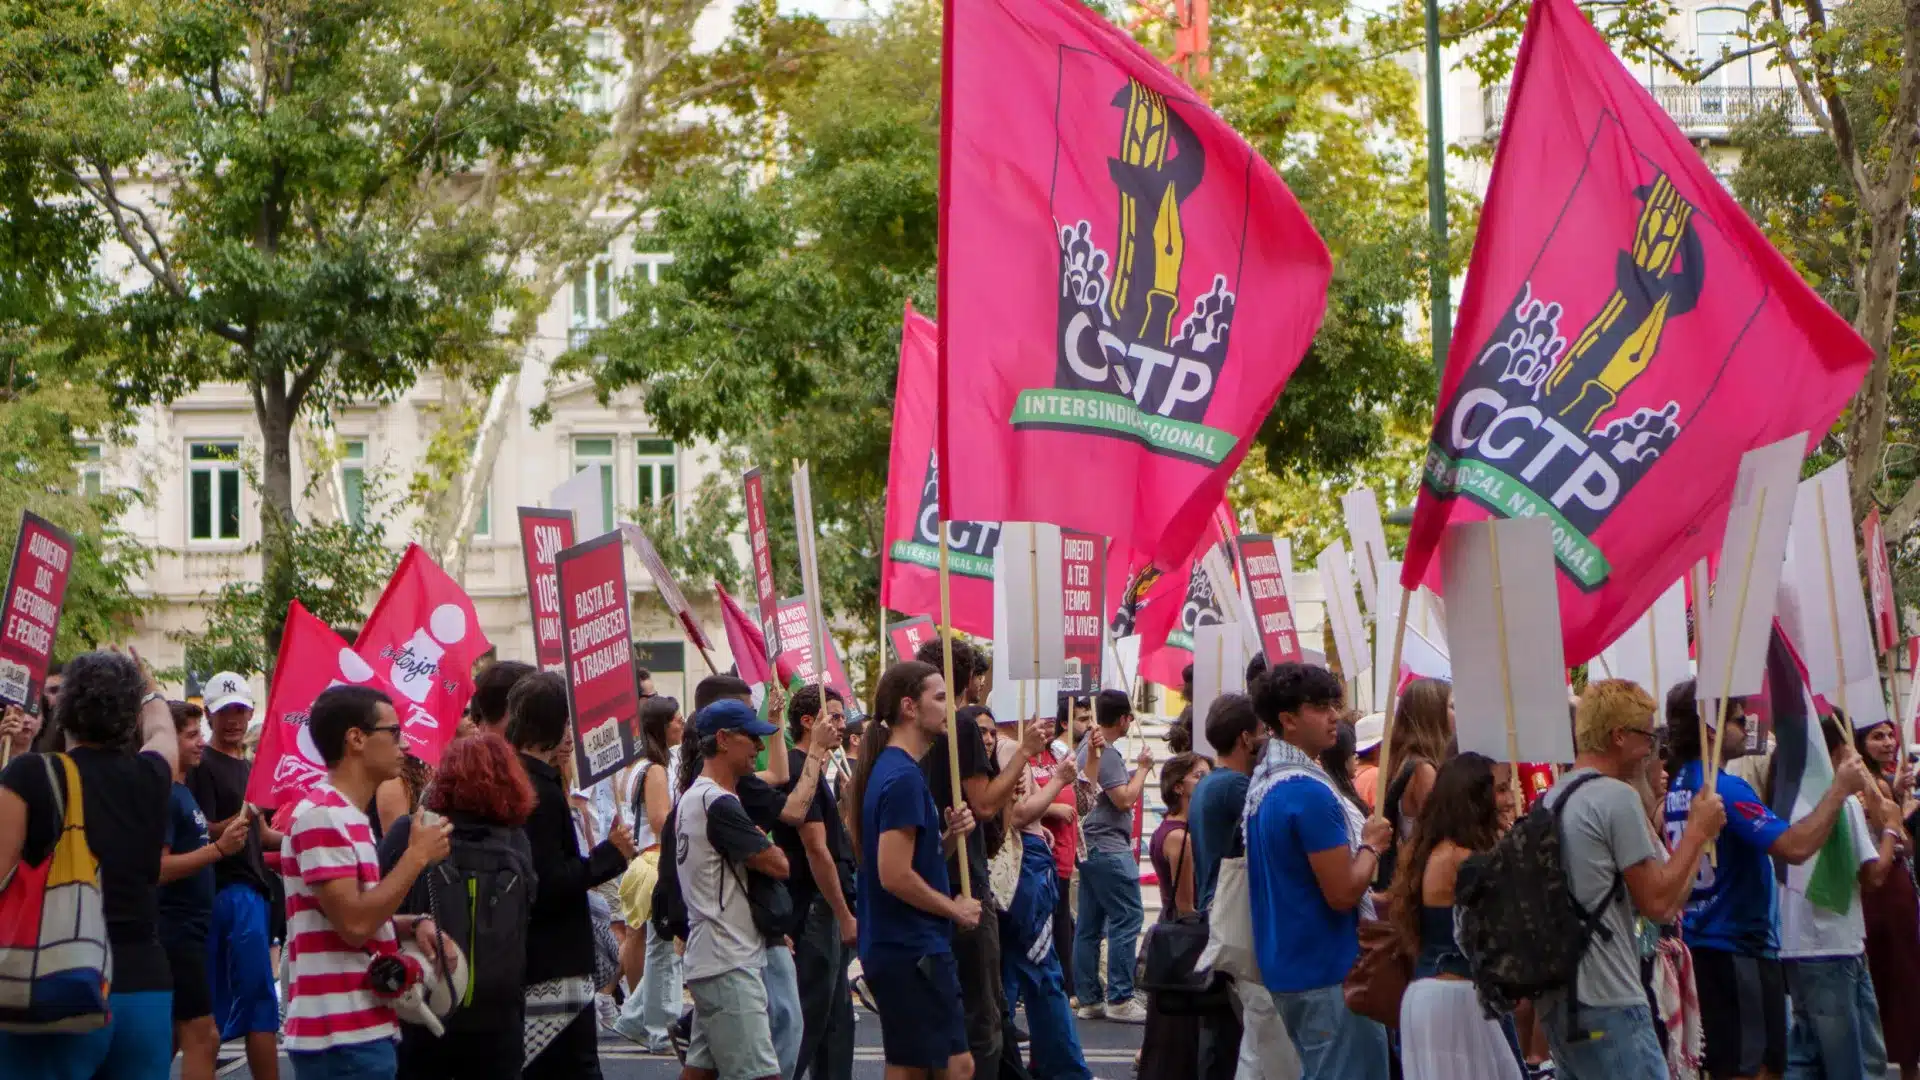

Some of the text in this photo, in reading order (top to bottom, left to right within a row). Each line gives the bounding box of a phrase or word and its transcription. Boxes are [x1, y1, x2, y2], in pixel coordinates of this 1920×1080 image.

[1065, 311, 1213, 417] CGTP
[1451, 387, 1620, 511] CGTP
[920, 503, 1003, 555] CGT
[28, 531, 67, 572] AUMENTO
[1064, 539, 1094, 561] DIREITO
[34, 565, 54, 594] DAS
[1067, 565, 1089, 586] A TER
[13, 585, 57, 629] REFORMAS
[575, 580, 616, 619] BASTA DE
[1065, 590, 1091, 611] TEMPO
[7, 614, 18, 638] E
[569, 607, 626, 654] EMPOBRECER
[1064, 615, 1075, 636] RA
[1076, 615, 1099, 636] VIVER
[573, 637, 630, 687] A TRABALHAR
